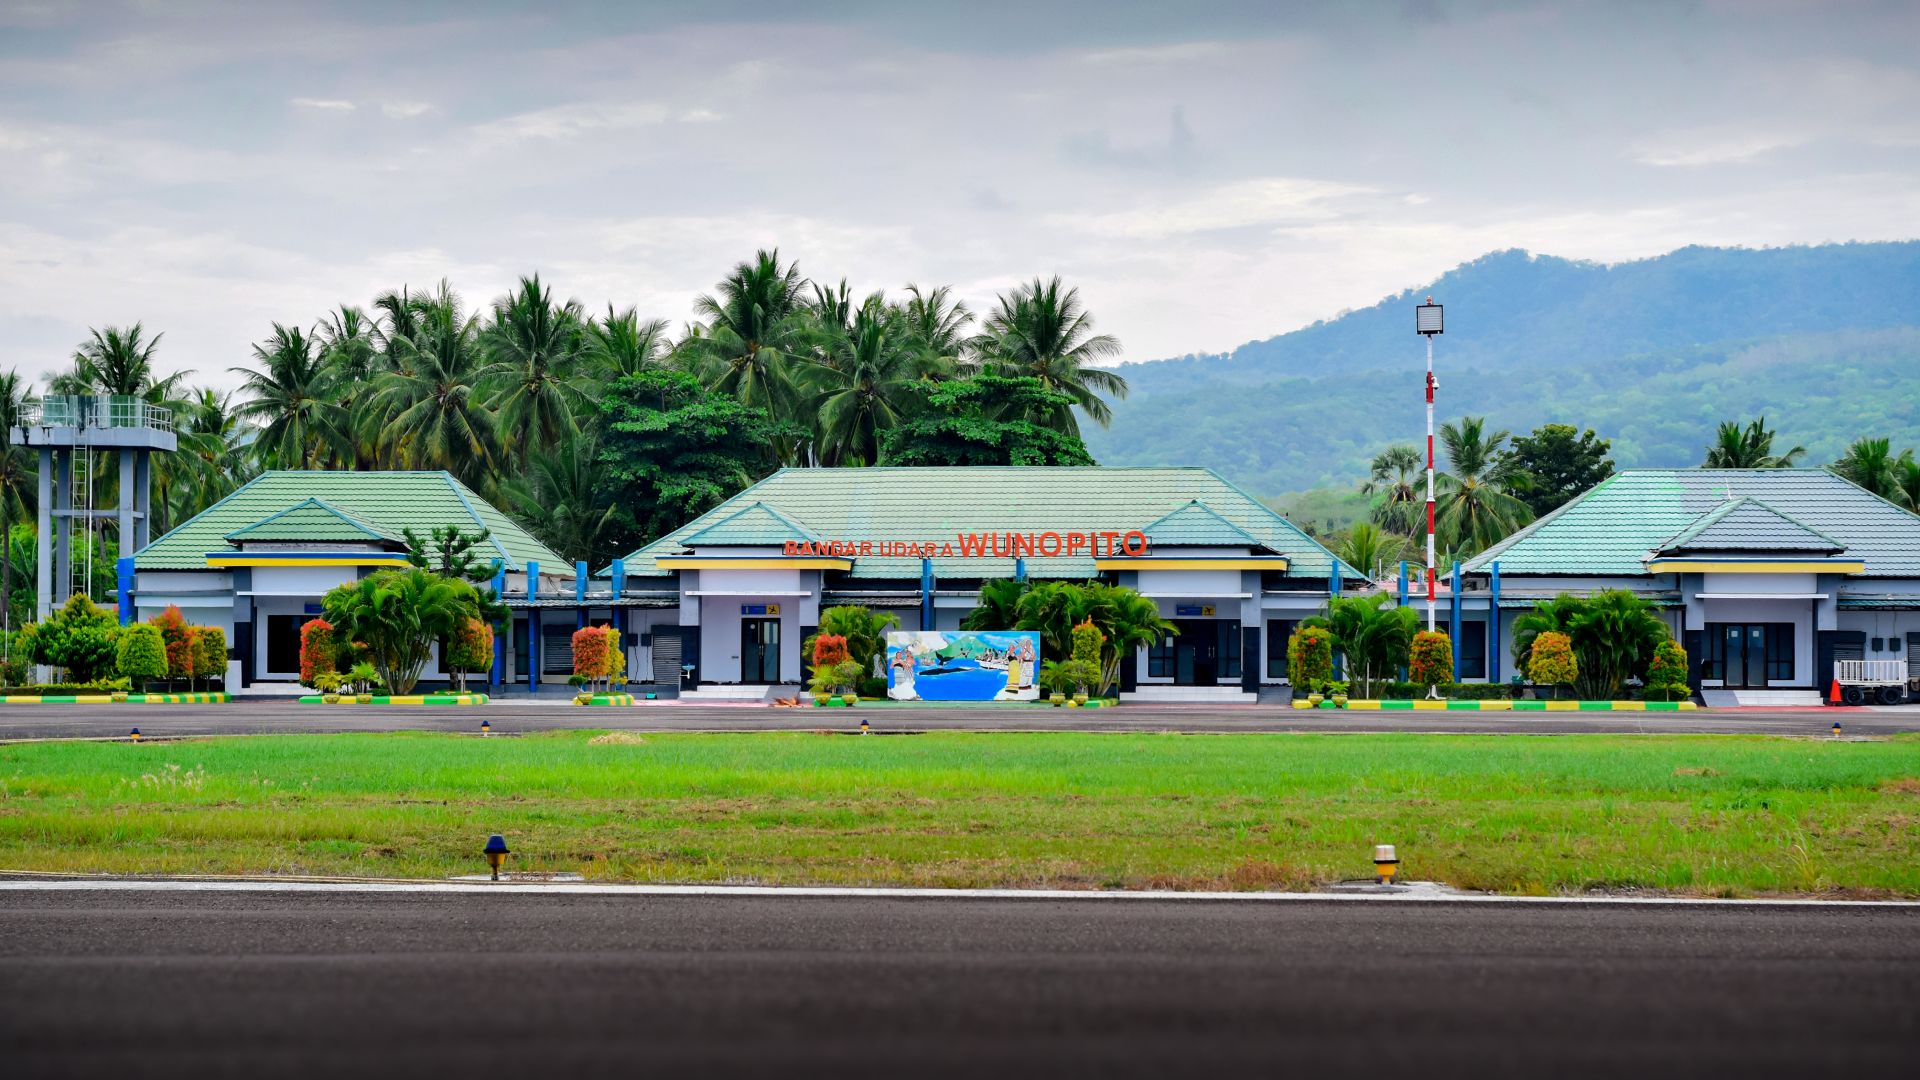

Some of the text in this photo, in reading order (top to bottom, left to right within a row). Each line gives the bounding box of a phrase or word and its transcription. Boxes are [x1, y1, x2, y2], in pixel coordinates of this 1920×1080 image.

[784, 530, 1147, 558] BANDAR UDARA WUNOPITO
